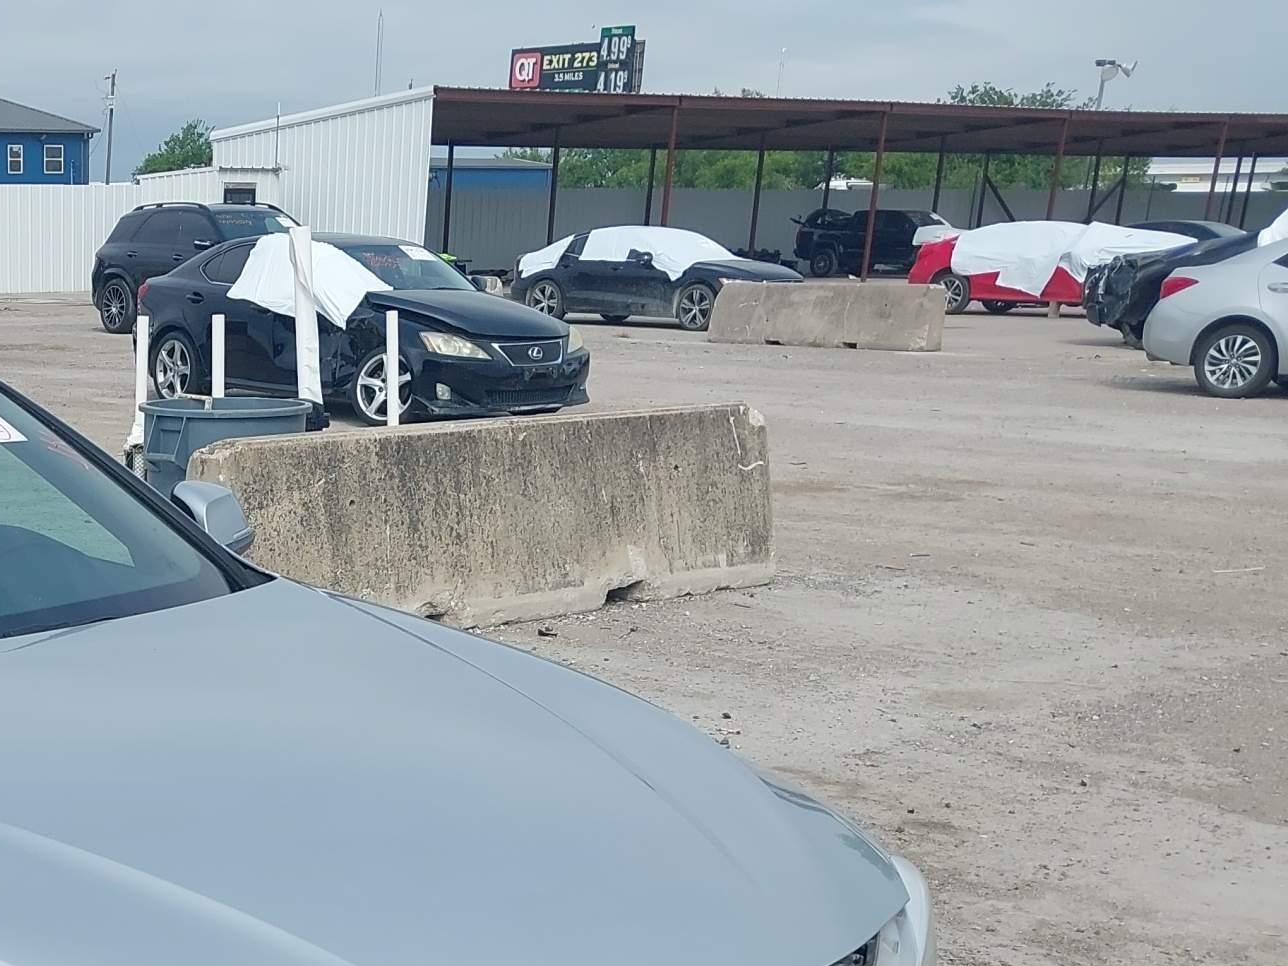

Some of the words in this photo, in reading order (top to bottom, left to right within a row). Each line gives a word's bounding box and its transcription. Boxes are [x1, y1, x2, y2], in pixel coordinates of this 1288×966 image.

[515, 57, 537, 83] QT
[542, 54, 571, 70] EXIT
[573, 51, 598, 68] 273
[564, 71, 583, 81] MILES
